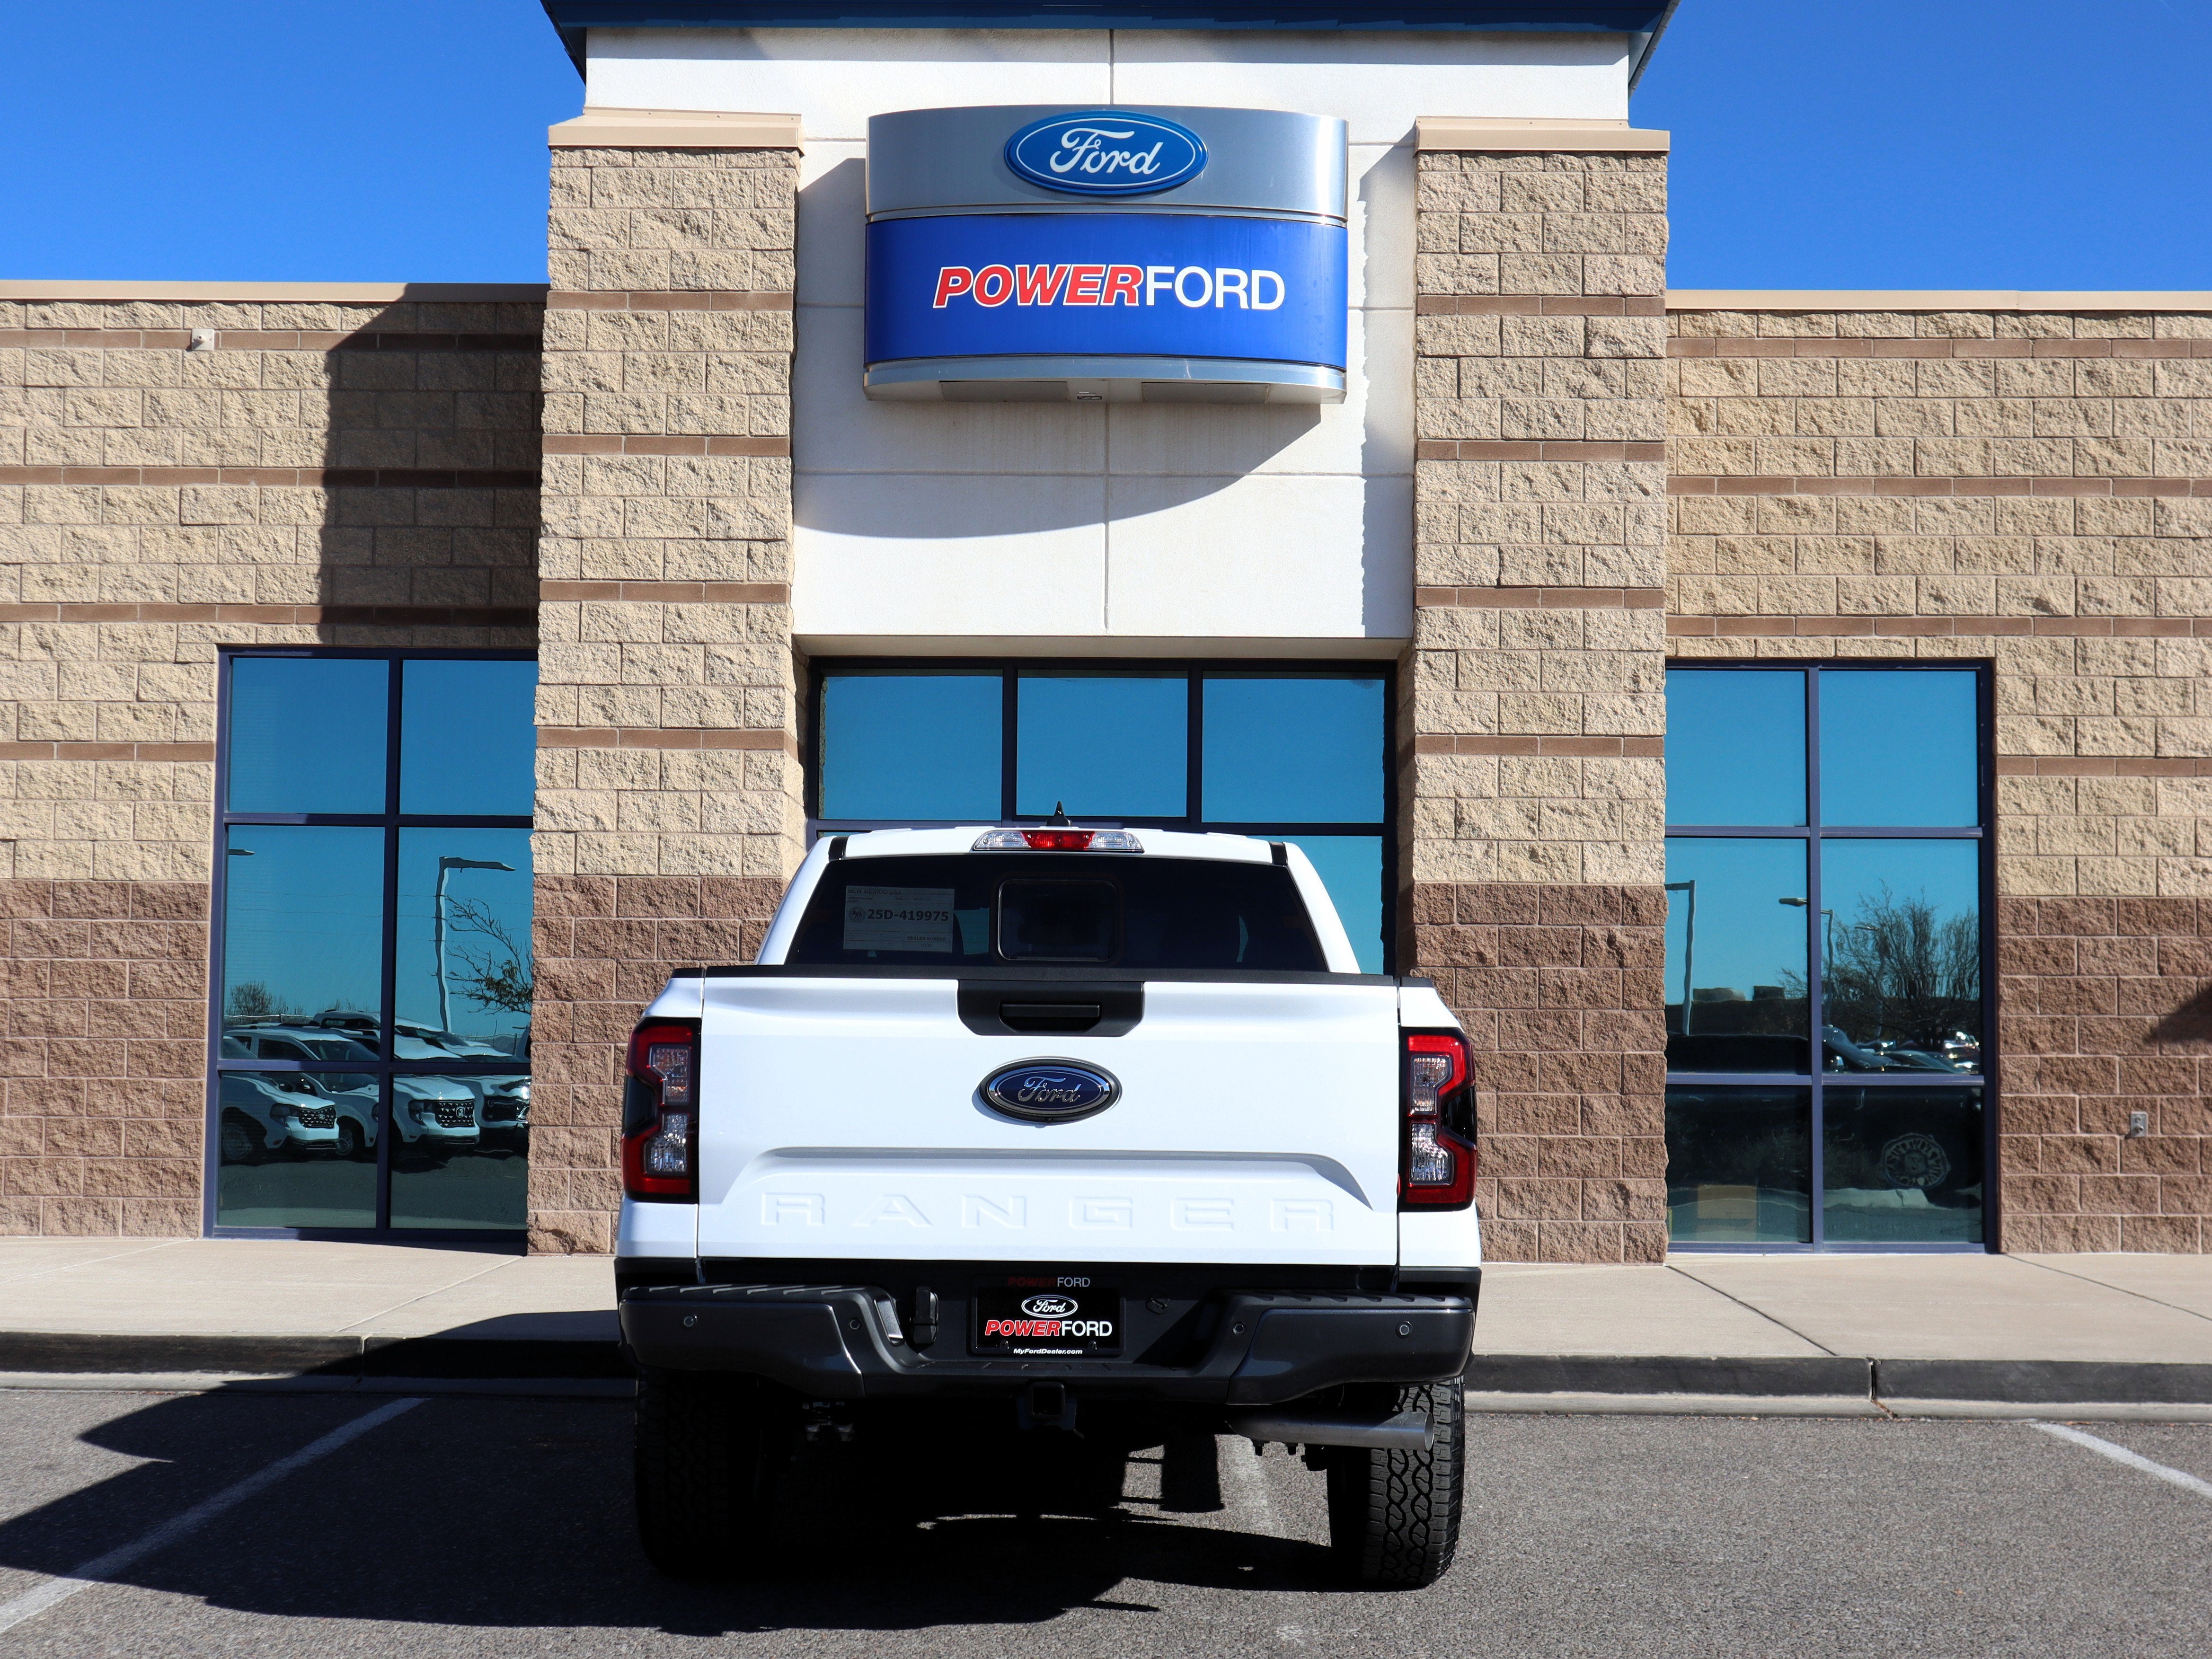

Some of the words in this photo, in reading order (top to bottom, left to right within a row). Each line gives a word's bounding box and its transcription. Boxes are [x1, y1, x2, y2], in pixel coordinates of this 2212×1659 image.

[1049, 128, 1163, 176] Ford
[867, 909, 949, 921] 25D-419975
[1018, 1076, 1082, 1103] Ford
[761, 1191, 1335, 1232] RANGER
[1033, 1299, 1066, 1313] Ford
